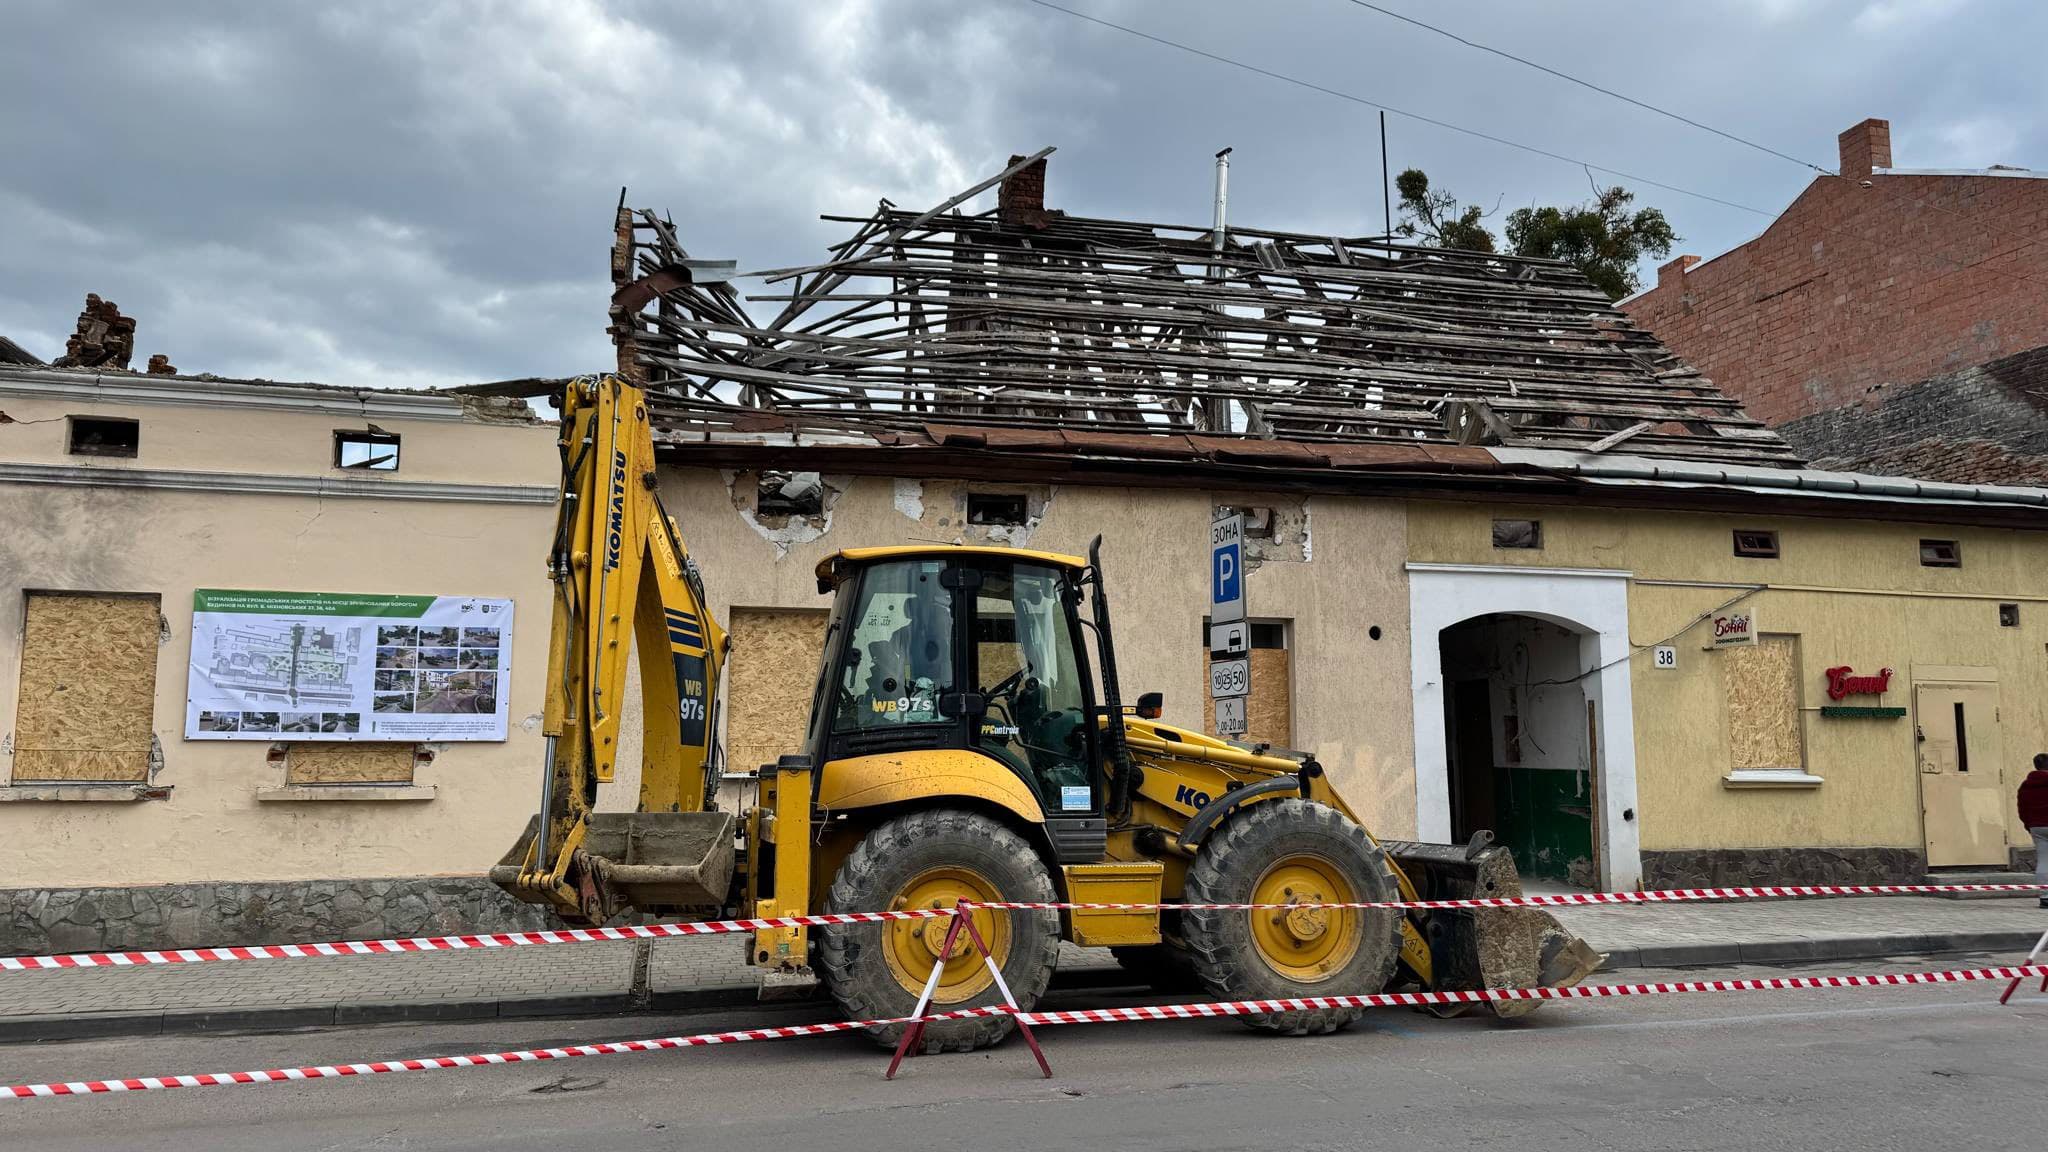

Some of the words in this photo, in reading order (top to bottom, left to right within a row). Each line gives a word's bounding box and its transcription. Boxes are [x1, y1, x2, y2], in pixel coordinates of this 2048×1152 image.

[608, 450, 627, 569] KOMATSU
[1213, 521, 1239, 544] ЗОНА
[1714, 616, 1748, 637] Бонні
[1659, 650, 1673, 665] 38
[1233, 670, 1244, 685] 50
[684, 679, 702, 697] WB
